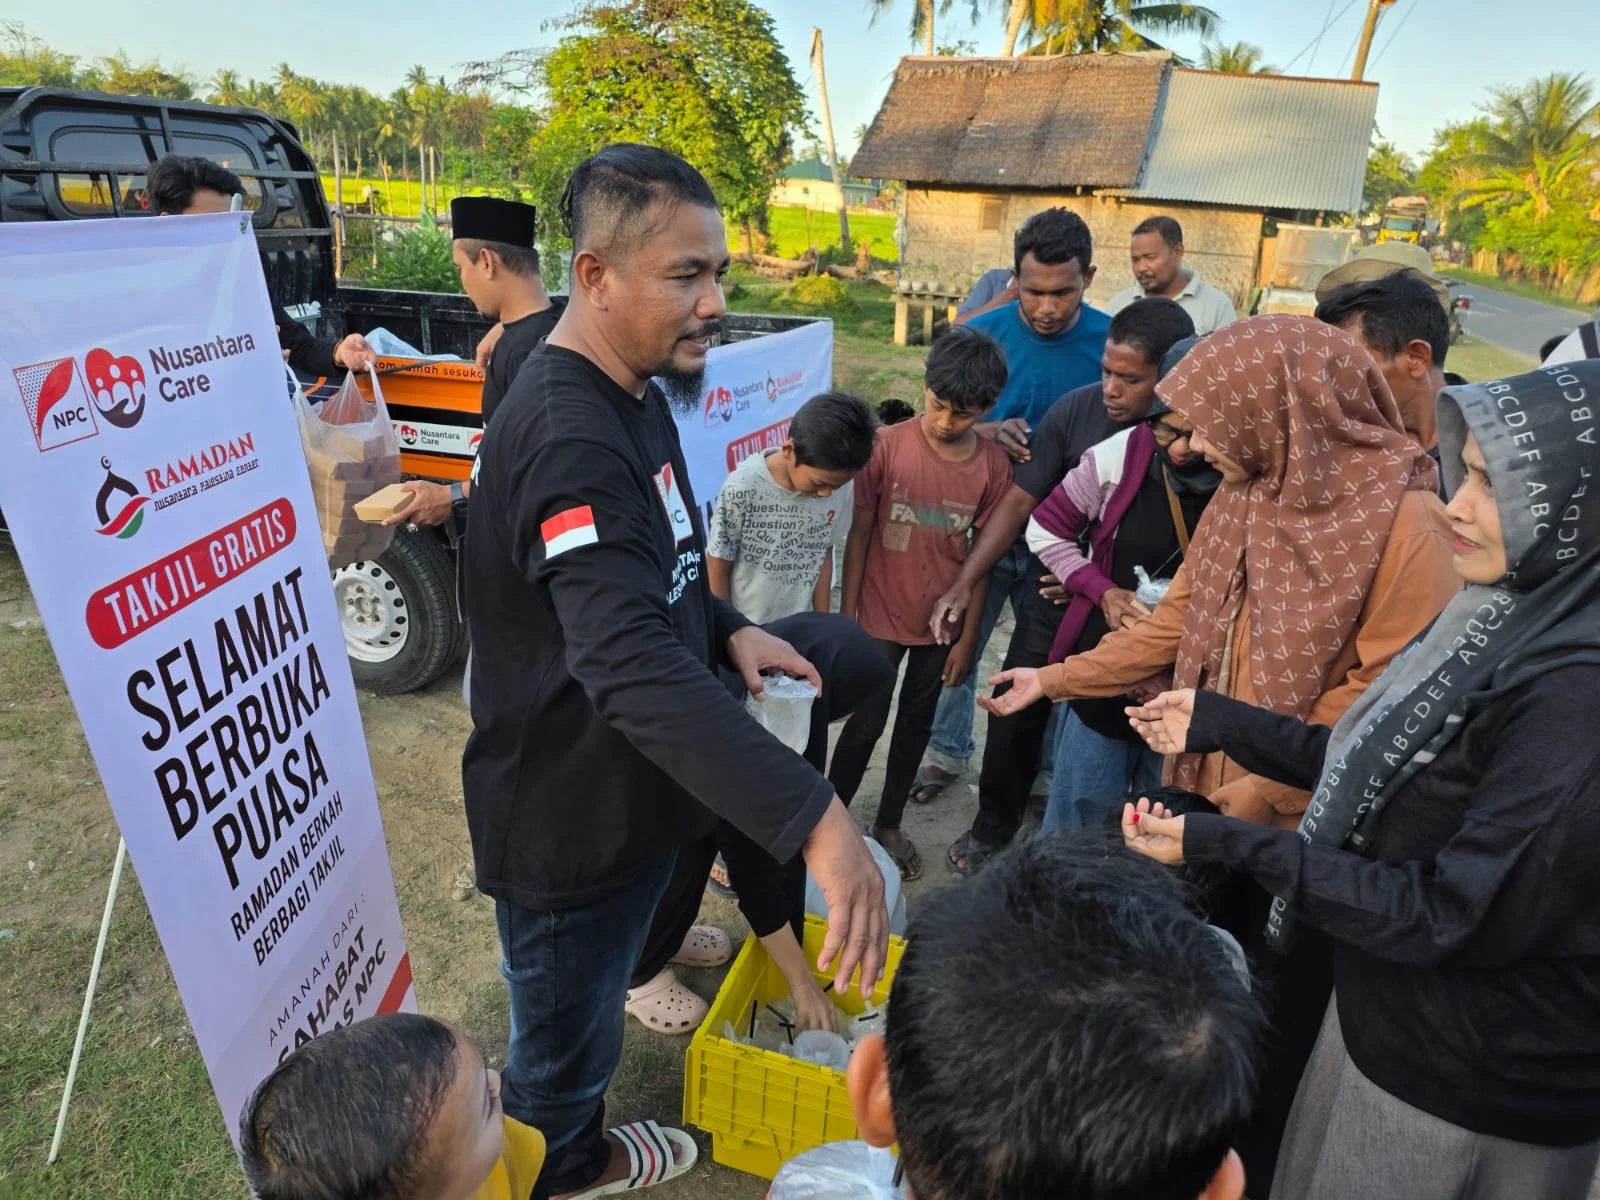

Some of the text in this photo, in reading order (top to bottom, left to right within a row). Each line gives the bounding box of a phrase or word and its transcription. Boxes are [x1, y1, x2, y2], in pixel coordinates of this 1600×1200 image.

[149, 333, 256, 375] Nusantara
[159, 374, 211, 403] Care
[53, 406, 88, 430] NPC
[420, 429, 461, 440] Nusantara
[421, 437, 440, 446] Care
[1485, 381, 1541, 462] BCDEF
[145, 432, 256, 495] RAMADAN
[104, 508, 287, 635] TAKJIL GRATIS
[127, 566, 309, 751] SELAMAT
[154, 642, 331, 841] BERBUKA
[1384, 670, 1452, 766] ABCDEF
[212, 730, 329, 891] PUASA
[230, 790, 344, 942] RAMADAN BERKAH
[253, 834, 345, 967] BERBAGI TAKJIL
[269, 950, 331, 1047] AMANAH
[354, 938, 386, 1005] NPC
